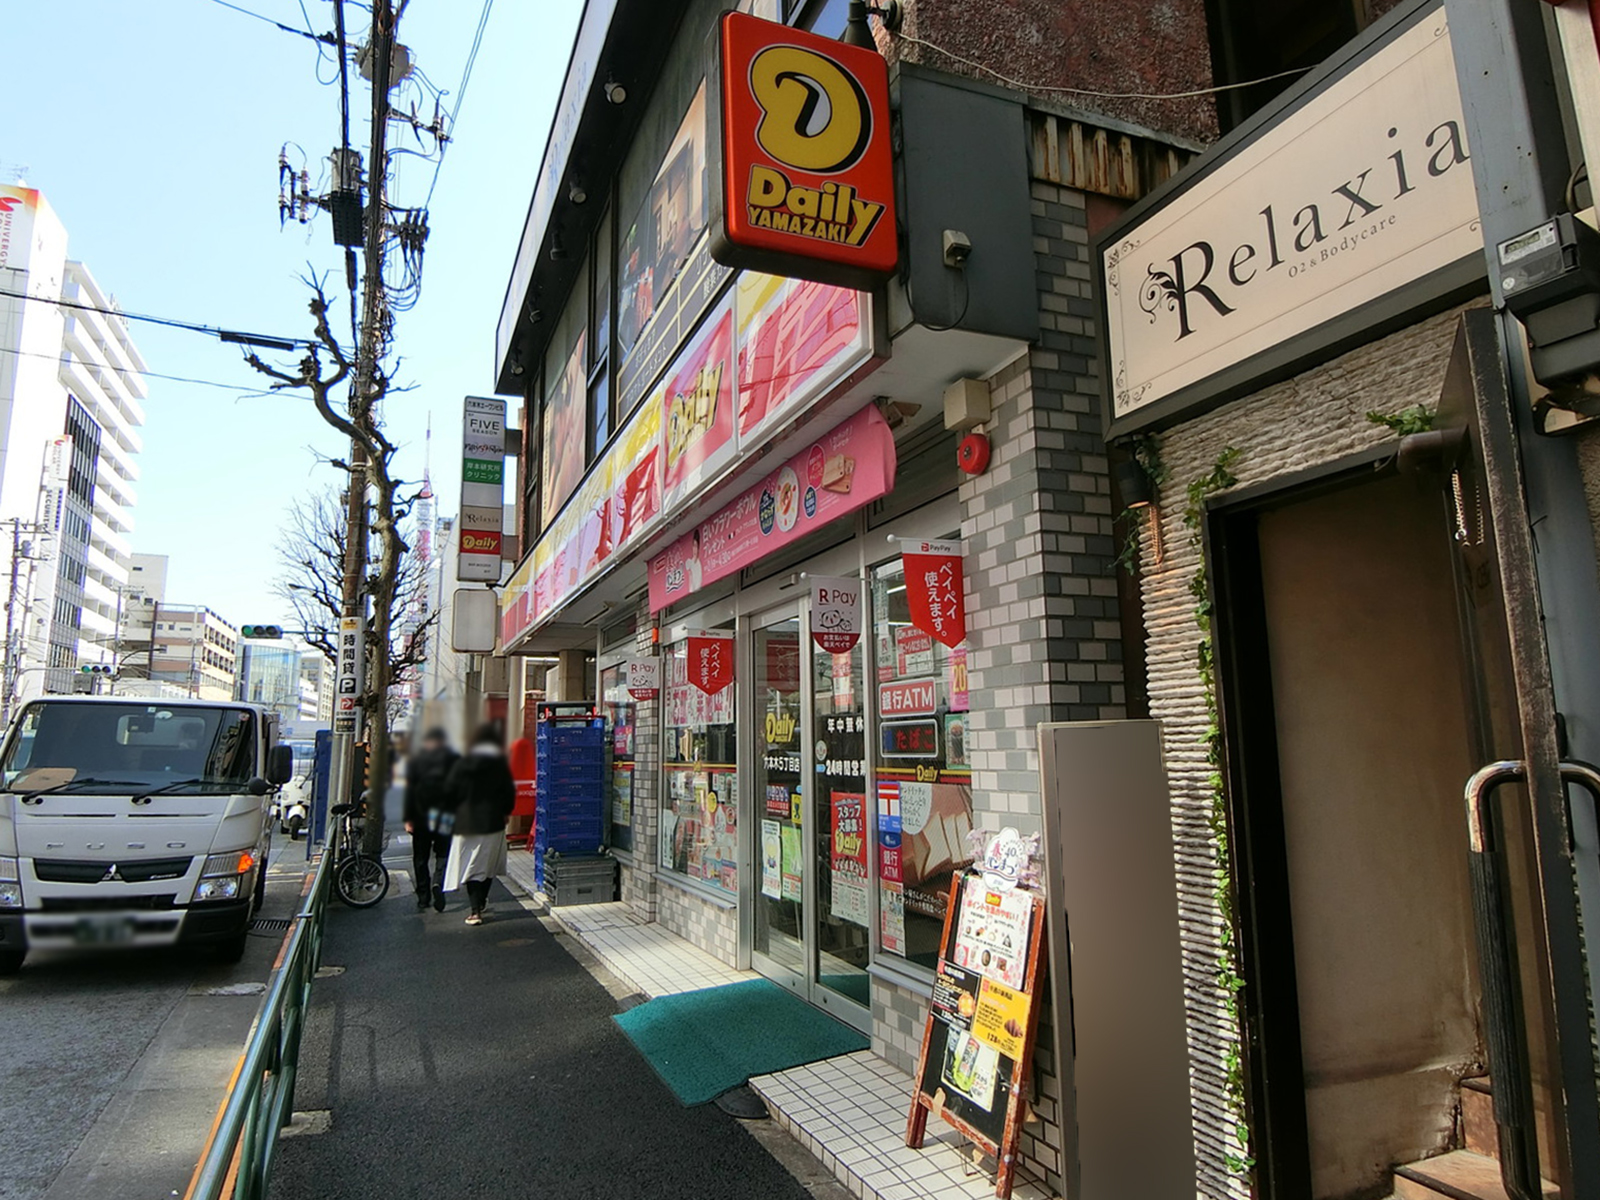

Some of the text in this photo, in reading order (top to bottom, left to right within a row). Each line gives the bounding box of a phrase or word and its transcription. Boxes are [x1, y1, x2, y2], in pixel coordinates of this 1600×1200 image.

[748, 163, 887, 248] Daily
[749, 206, 848, 243] YAMAZAKI
[1139, 119, 1471, 343] Relaxia
[1320, 212, 1398, 263] Bodycare
[470, 418, 500, 431] FIVE
[466, 471, 500, 480] クリニック
[462, 535, 497, 550] Daily
[930, 544, 951, 552] PayPay
[818, 588, 857, 607] R Pay
[939, 561, 958, 620] ペイペイ
[924, 571, 948, 637] 使えます。
[343, 633, 356, 675] 時間貸
[710, 642, 720, 678] ペイペイ
[640, 664, 656, 674] Pay
[881, 685, 933, 711] 銀行ATM
[765, 712, 796, 744] Daily
[827, 715, 865, 734] 年中無休
[895, 727, 935, 750] たばこ
[916, 764, 938, 782] Daily
[838, 804, 862, 819] スタッフ
[46, 842, 187, 850] FUSO
[883, 865, 899, 879] ATM
